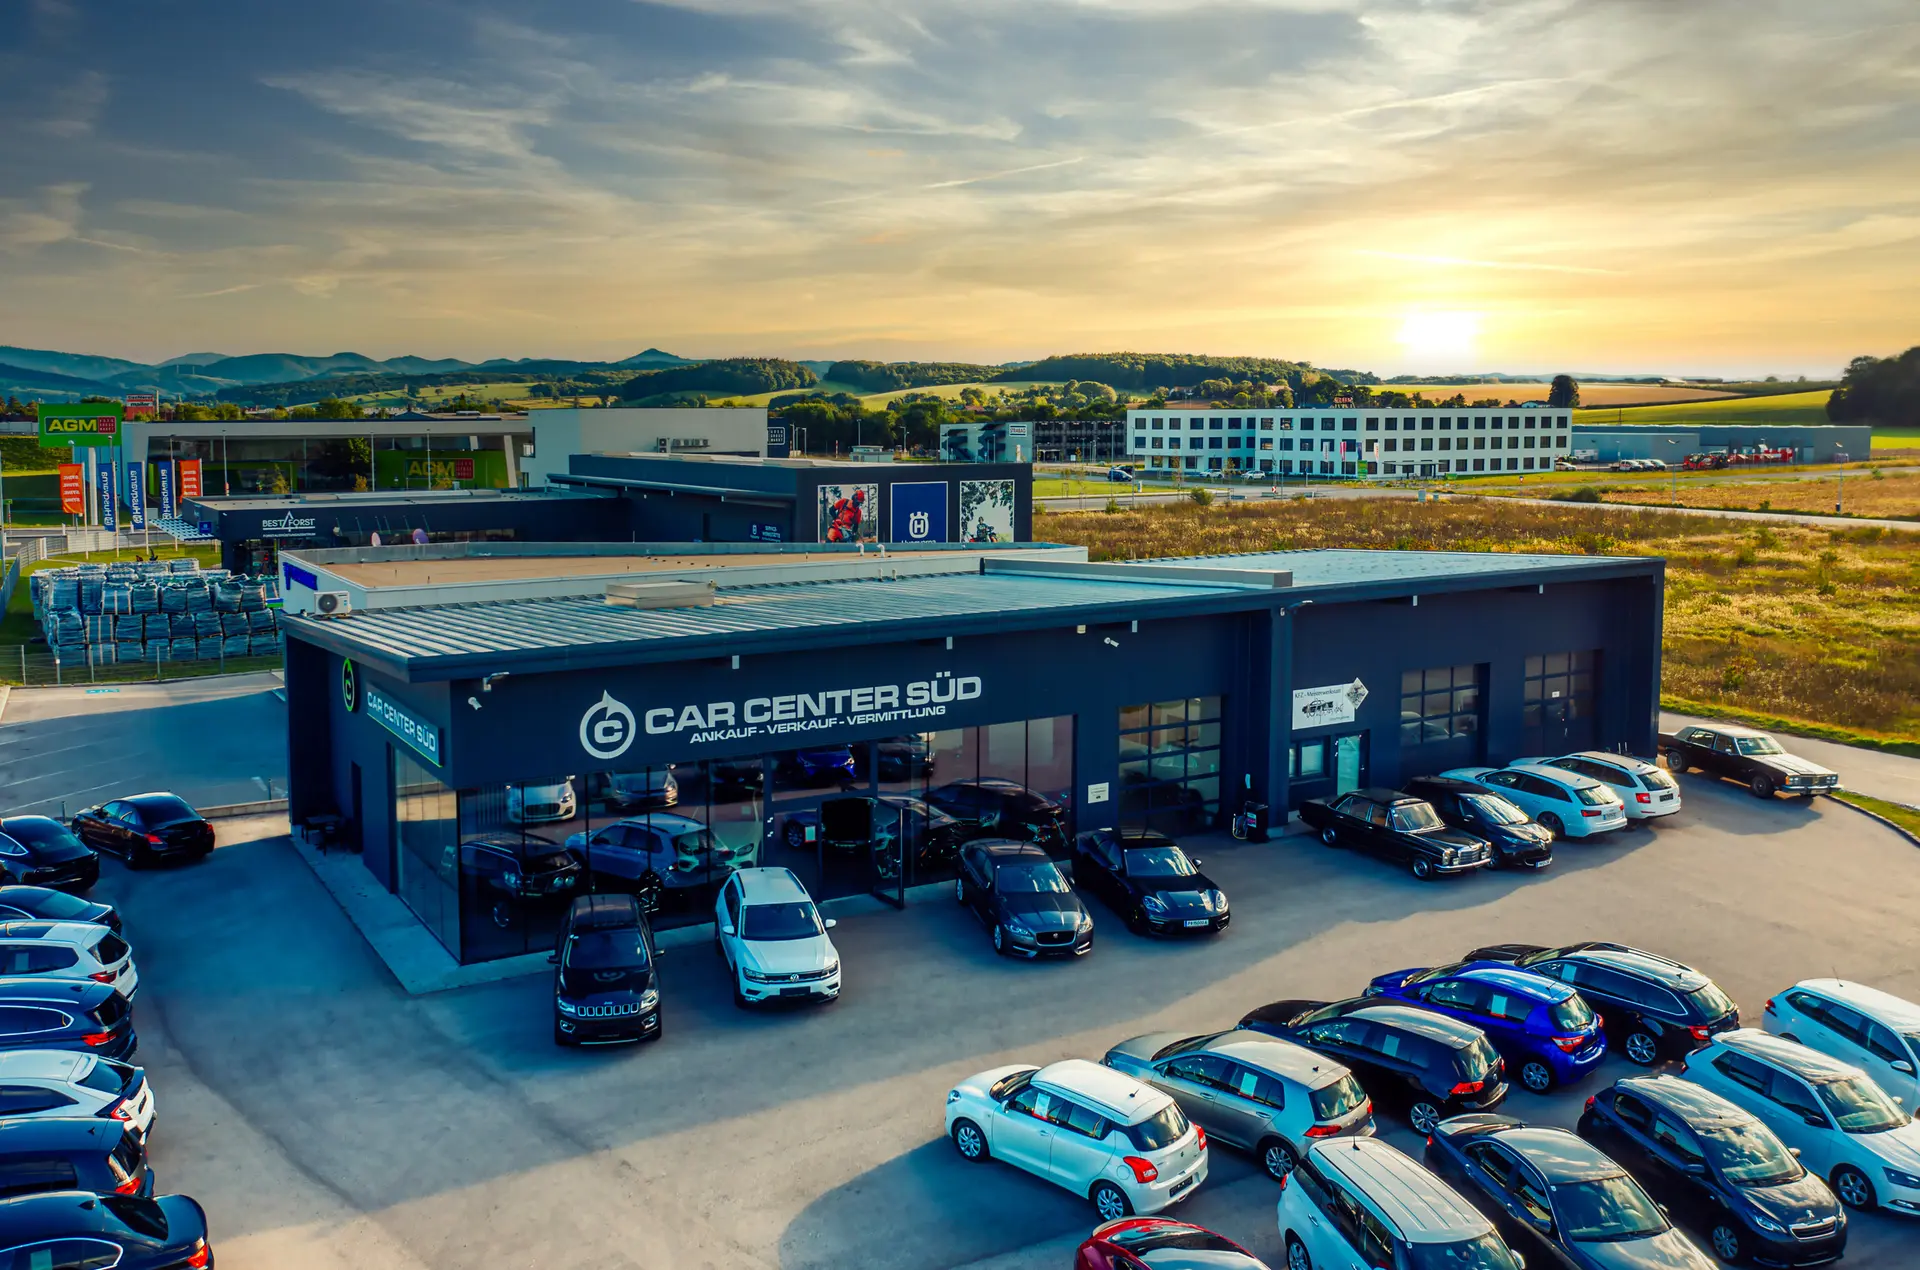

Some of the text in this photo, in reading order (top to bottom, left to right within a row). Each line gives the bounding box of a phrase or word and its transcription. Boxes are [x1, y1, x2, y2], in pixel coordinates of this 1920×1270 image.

[48, 419, 97, 432] AGM
[367, 691, 436, 752] CAR CENTER SÜD
[645, 671, 982, 734] CAR CENTER SÜD
[690, 726, 757, 743] ANKAUF
[767, 718, 837, 734] VERKAUF
[847, 706, 946, 725] VERMITTLUNG
